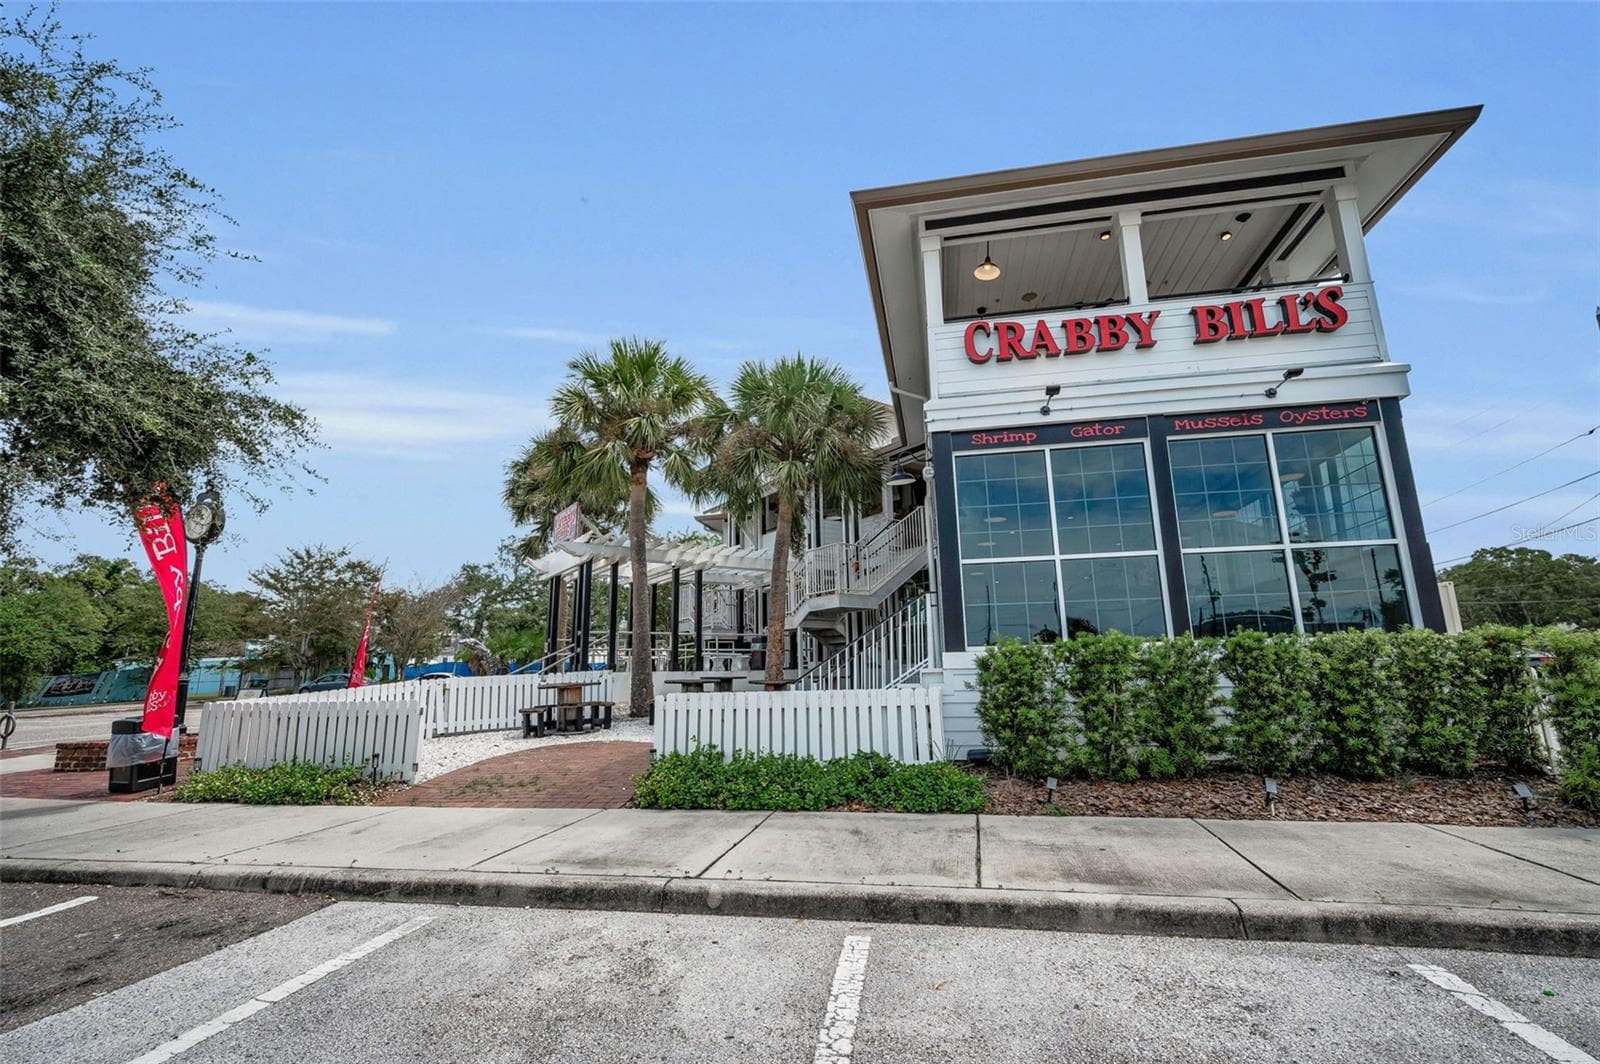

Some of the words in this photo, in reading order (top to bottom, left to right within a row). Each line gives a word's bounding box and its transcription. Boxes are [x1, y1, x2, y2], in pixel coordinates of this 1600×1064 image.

[963, 310, 1161, 364] CRABBY
[1188, 286, 1348, 345] BILL'S
[1174, 413, 1264, 431] Mussels
[1279, 405, 1367, 425] Oysters
[971, 431, 1037, 446] Shrimp
[1070, 423, 1126, 438] Gator
